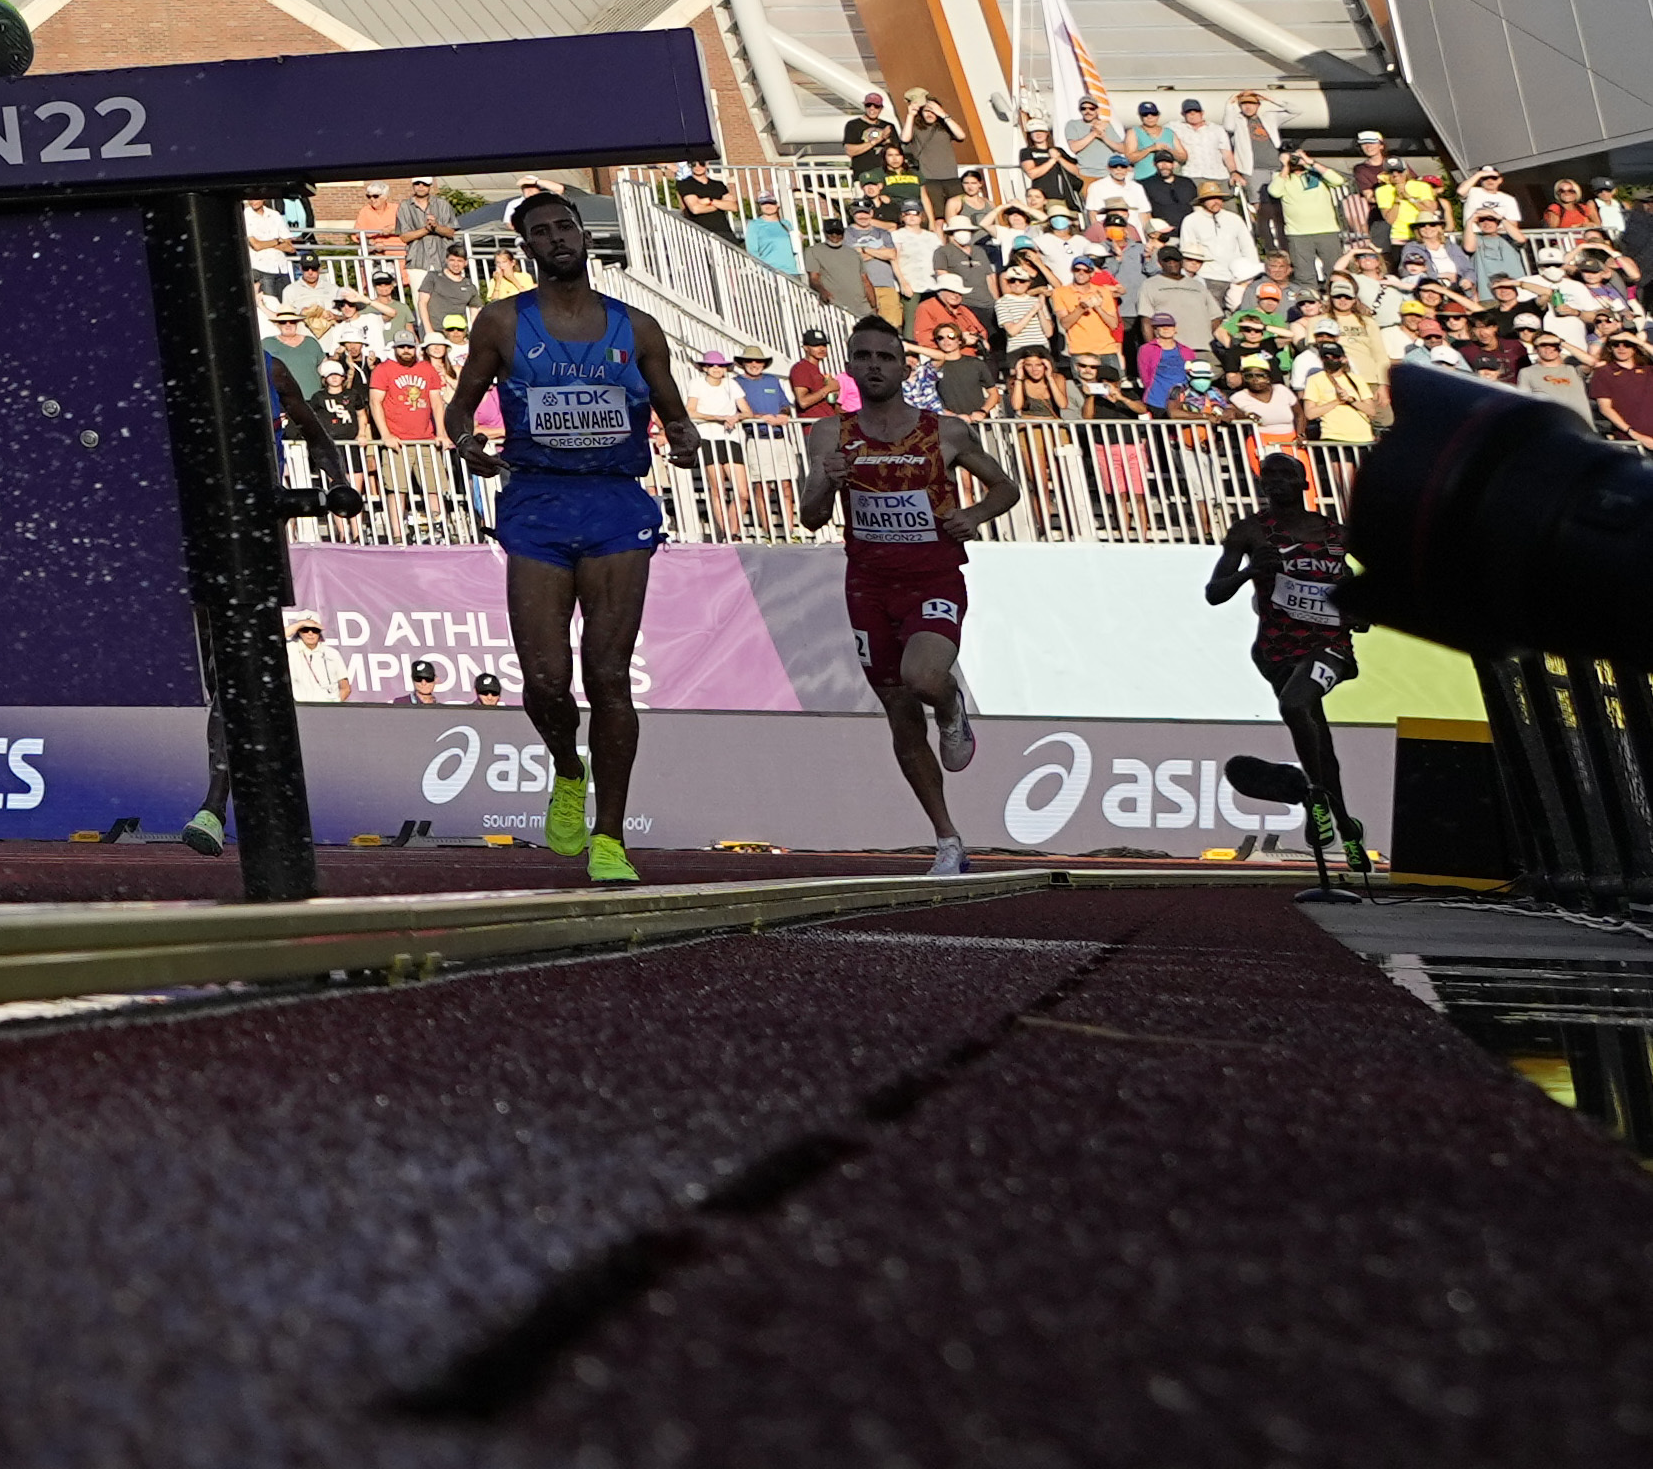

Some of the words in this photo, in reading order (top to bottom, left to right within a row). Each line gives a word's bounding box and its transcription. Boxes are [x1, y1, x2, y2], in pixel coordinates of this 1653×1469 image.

[551, 361, 606, 380] ITALIA
[556, 389, 611, 406] TDK
[535, 409, 624, 431] ABDELWAHED
[549, 436, 617, 447] OREGON22
[853, 454, 926, 466] ESPAÑA
[868, 493, 918, 508] TDK
[855, 510, 930, 528] MARTOS
[1295, 583, 1330, 597] TDK
[1286, 594, 1326, 612] BETT
[486, 743, 596, 793] asi
[482, 811, 528, 828] sound
[622, 813, 654, 834] ody
